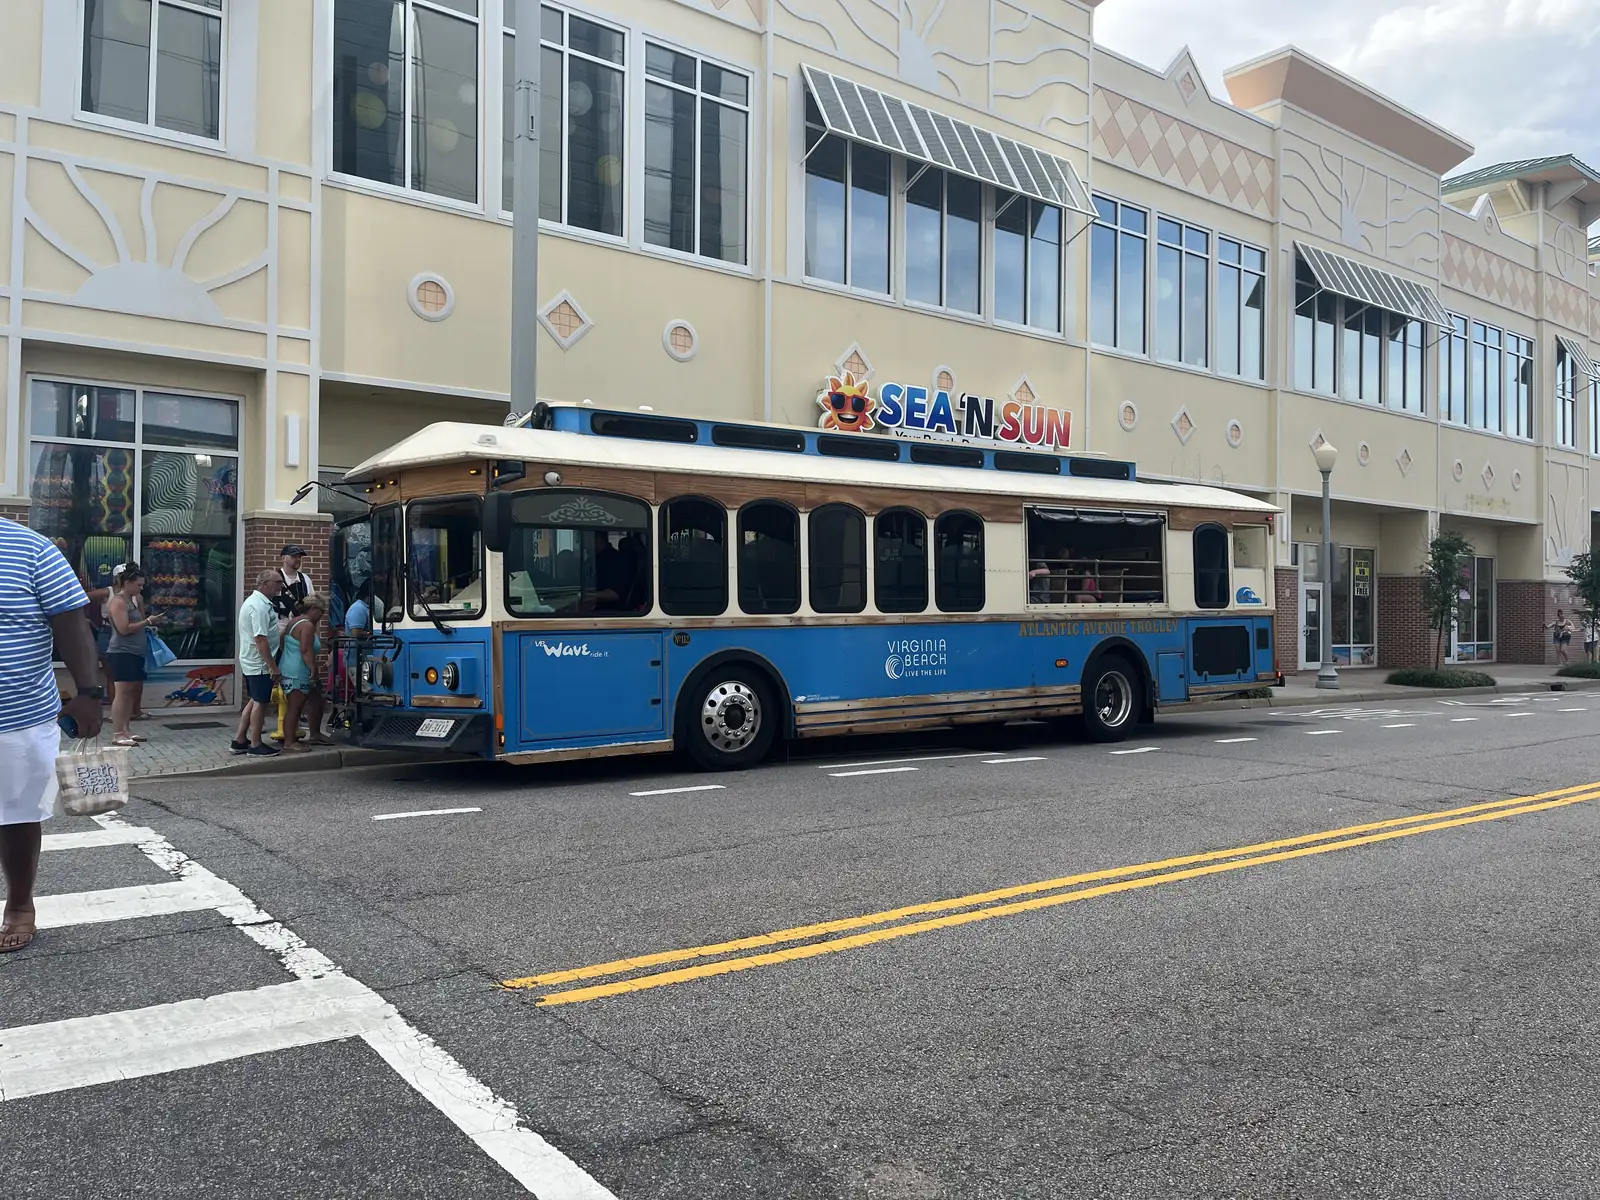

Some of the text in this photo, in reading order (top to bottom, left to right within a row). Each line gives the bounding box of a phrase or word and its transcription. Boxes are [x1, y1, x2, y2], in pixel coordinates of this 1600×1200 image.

[876, 382, 957, 434] SEA
[998, 401, 1072, 449] SUN
[1019, 619, 1178, 637] ATLANTIC AVENUE TROLLEY
[543, 641, 591, 657] Wave
[887, 639, 947, 653] VIRGINIA
[904, 653, 947, 666] BEACH
[77, 764, 118, 778] Bath
[88, 775, 119, 786] Body
[81, 785, 119, 796] Works
